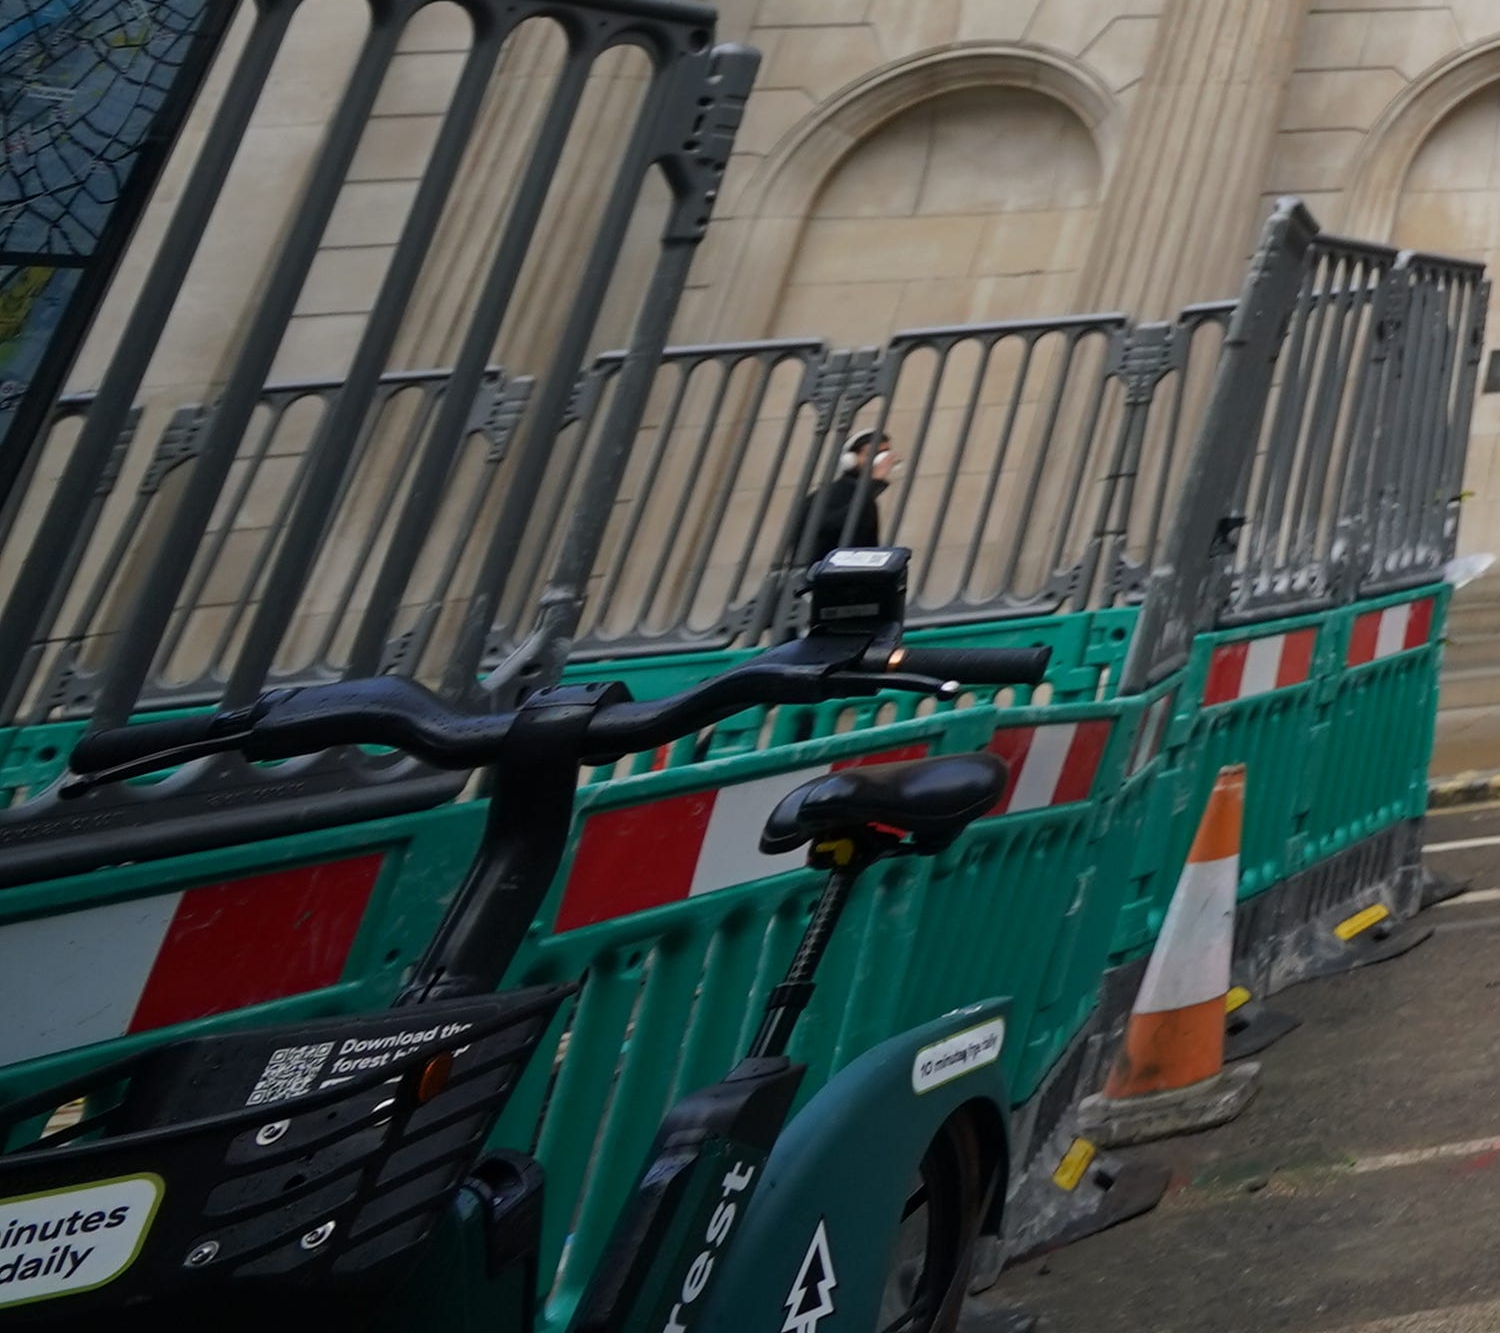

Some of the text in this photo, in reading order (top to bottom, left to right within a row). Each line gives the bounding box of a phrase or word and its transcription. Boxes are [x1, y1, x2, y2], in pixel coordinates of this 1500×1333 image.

[338, 1023, 440, 1055] Download
[330, 1050, 391, 1074] forest
[0, 1206, 130, 1249] inutes
[0, 1244, 96, 1284] daily
